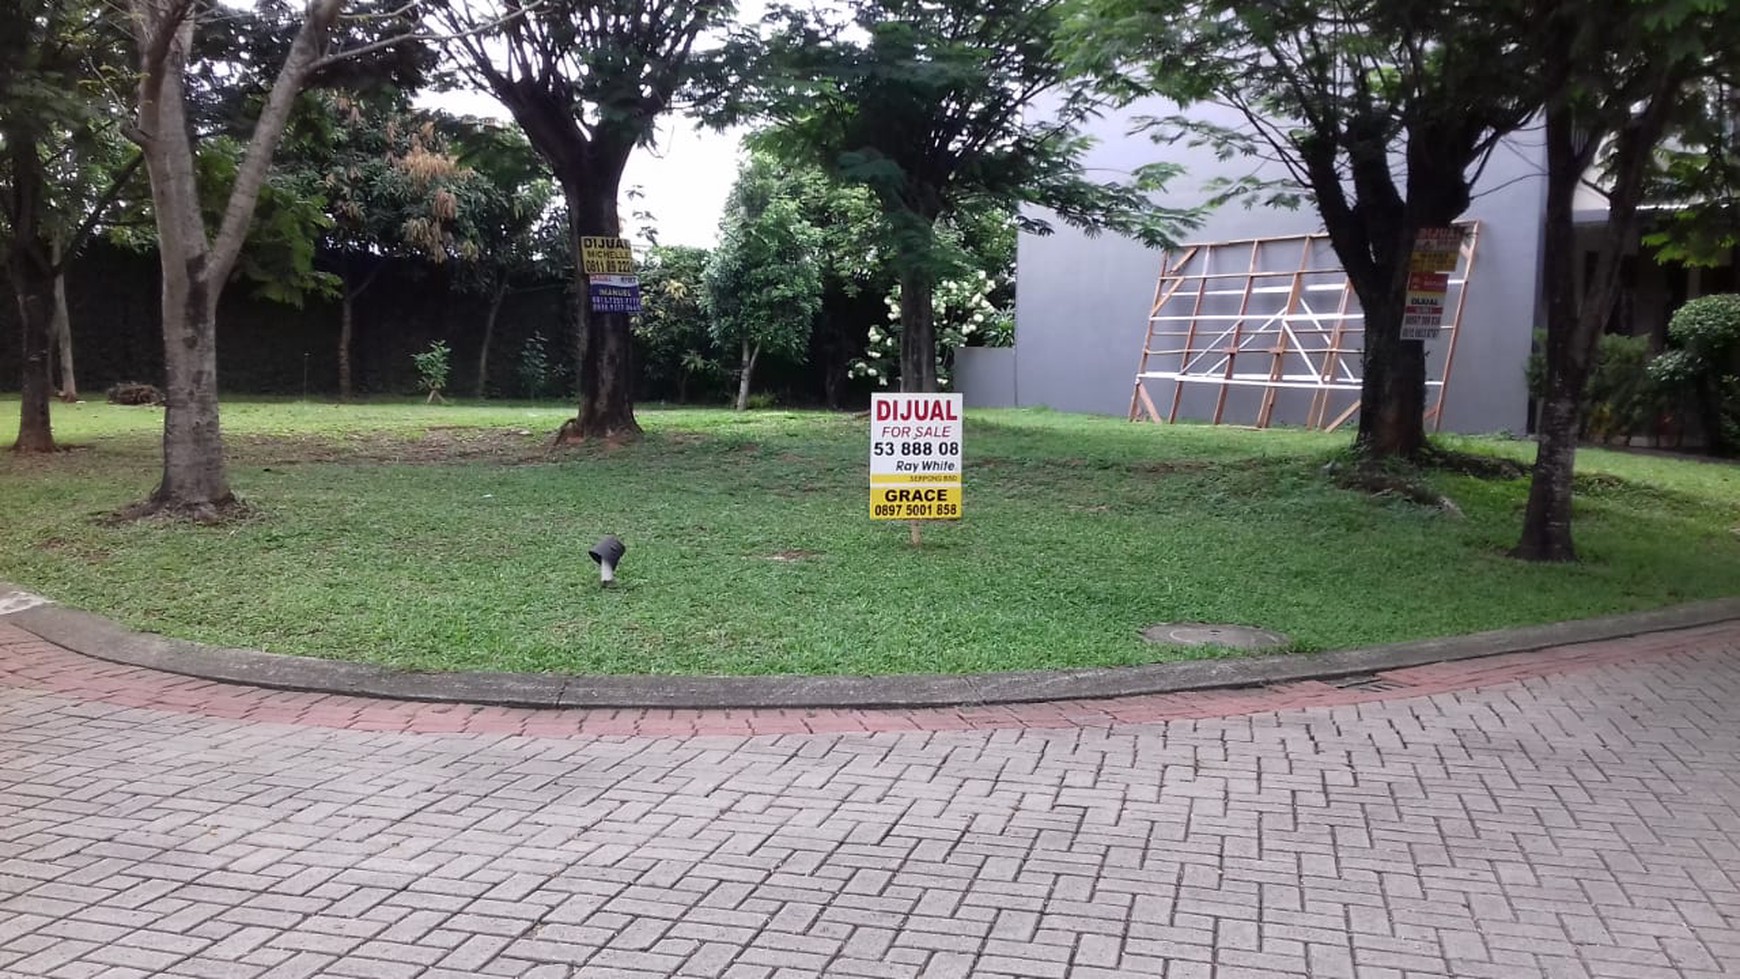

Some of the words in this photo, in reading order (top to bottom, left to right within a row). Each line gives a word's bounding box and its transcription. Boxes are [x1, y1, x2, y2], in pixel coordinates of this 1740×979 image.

[584, 238, 631, 249] DIJUAL
[587, 250, 630, 259] MICHELLE
[877, 400, 958, 421] DIJUAL
[882, 426, 911, 438] FOR
[915, 426, 952, 438] SALE
[874, 442, 895, 456] 53
[901, 442, 932, 456] 888
[939, 442, 959, 456] 08
[896, 460, 919, 473] Ray
[922, 460, 956, 471] White
[885, 489, 948, 502] GRACE
[875, 504, 902, 516] 0897
[906, 504, 932, 516] 5001
[937, 504, 957, 516] 858
